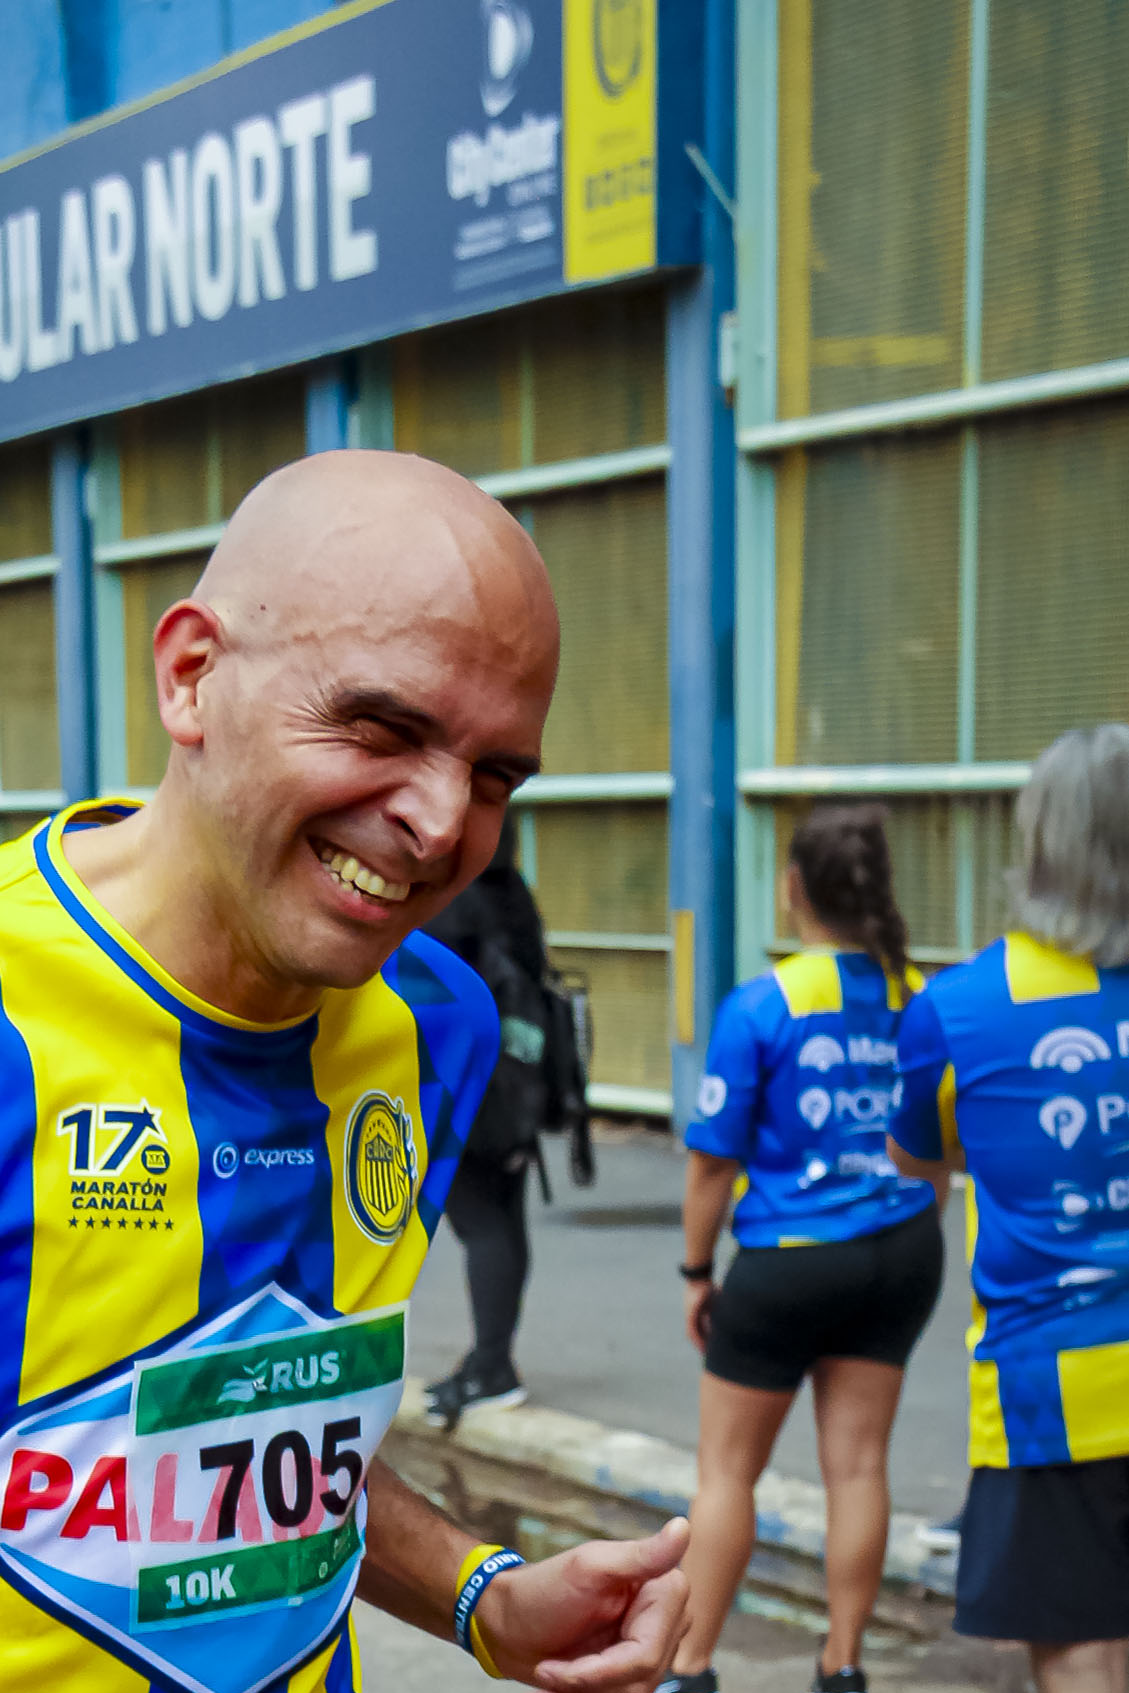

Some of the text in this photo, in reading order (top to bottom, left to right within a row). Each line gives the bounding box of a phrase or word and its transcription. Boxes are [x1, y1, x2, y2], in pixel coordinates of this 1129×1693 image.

[142, 73, 377, 337] NORTE
[57, 1101, 165, 1175] 17
[244, 1147, 315, 1168] express
[70, 1178, 168, 1197] MARATÓN
[71, 1196, 165, 1212] CANALLA
[270, 1351, 341, 1393] RUS
[199, 1417, 363, 1540] 705
[166, 1564, 236, 1609] 10K
